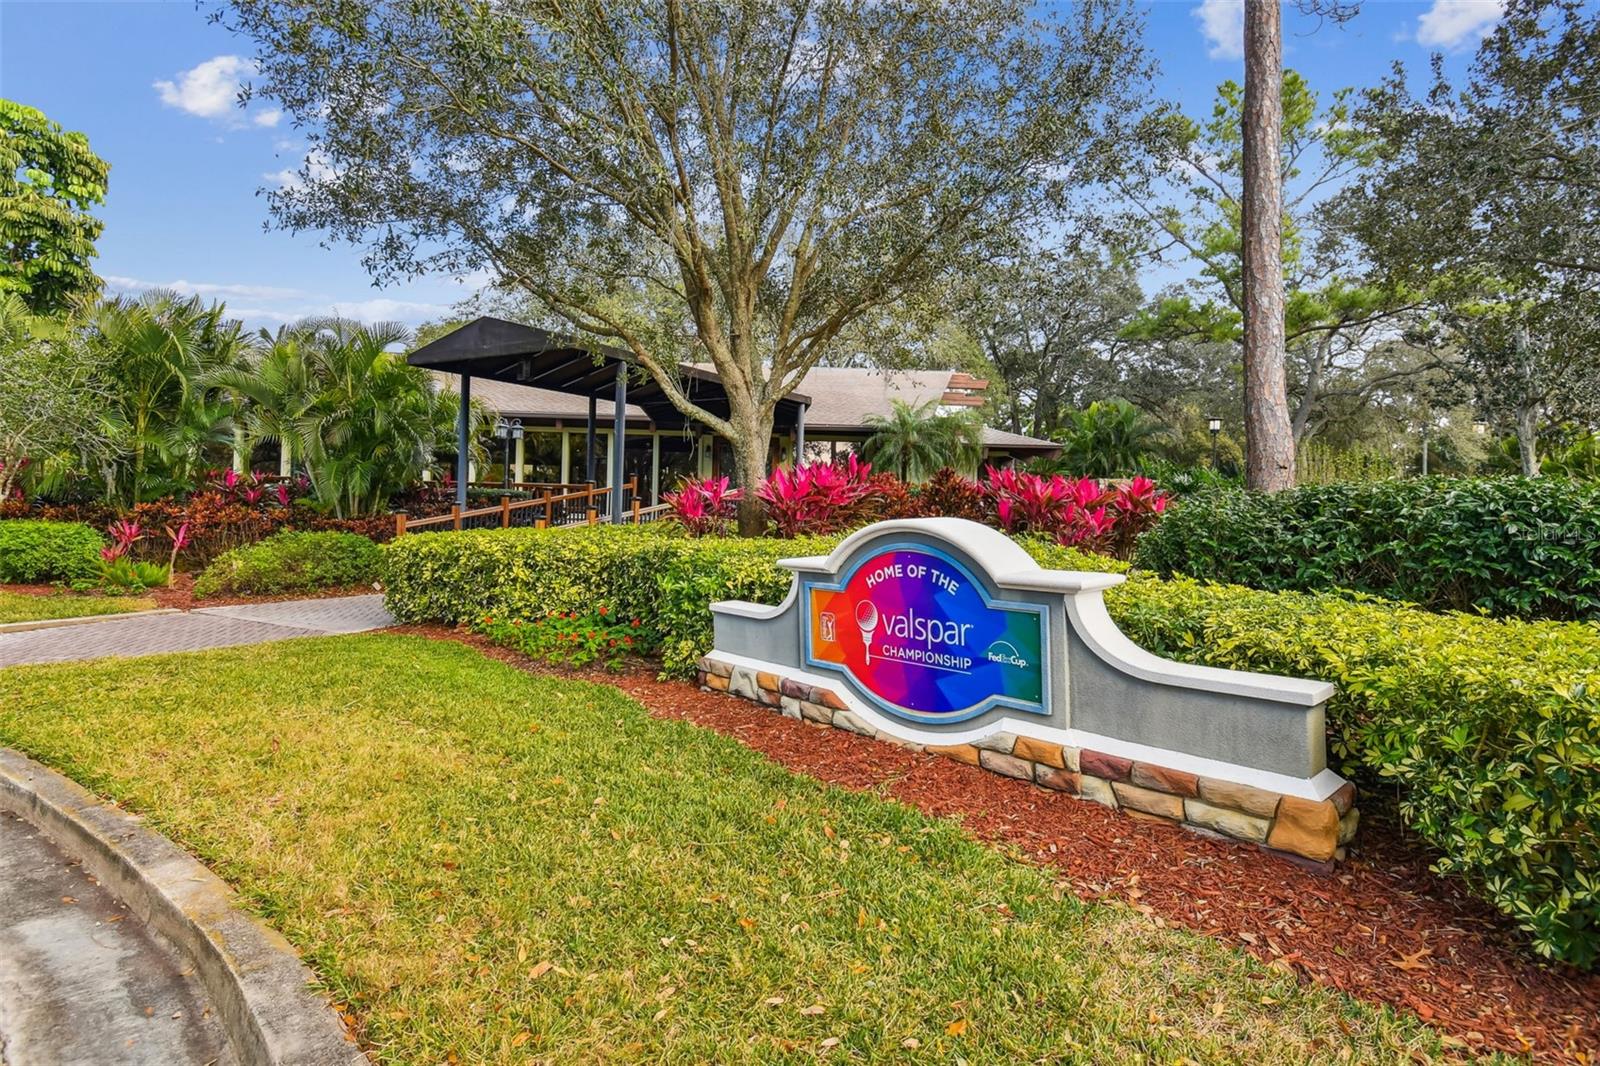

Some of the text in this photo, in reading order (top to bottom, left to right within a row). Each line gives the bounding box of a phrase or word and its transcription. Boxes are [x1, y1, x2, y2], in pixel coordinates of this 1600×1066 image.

[865, 564, 960, 596] HOME OF THE
[882, 607, 971, 650] valspar
[882, 644, 972, 670] CHAMPIONSHIP
